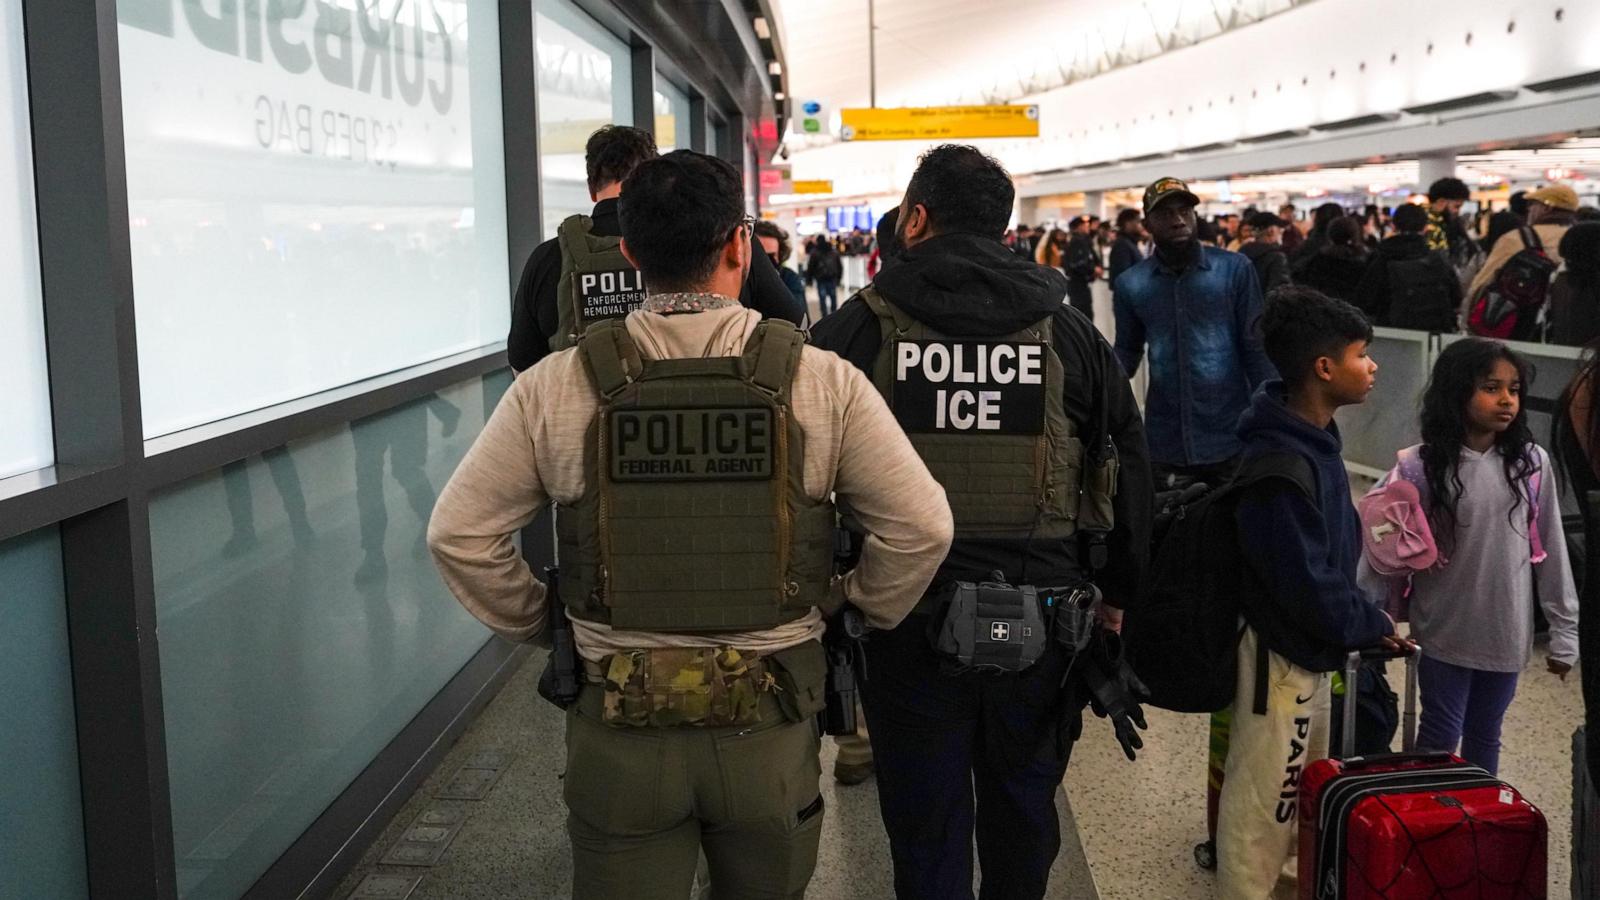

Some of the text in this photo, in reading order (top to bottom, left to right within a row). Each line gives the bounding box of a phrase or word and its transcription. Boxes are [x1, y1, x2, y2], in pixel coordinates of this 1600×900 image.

[581, 270, 643, 295] POLI
[588, 292, 646, 306] ENFORCEMEN
[584, 305, 625, 317] REMOVAL
[897, 342, 1042, 385] POLICE
[936, 389, 1002, 430] ICE
[617, 412, 766, 456] POLICE
[619, 457, 765, 475] FEDERAL AGENT
[1275, 716, 1311, 824] PARIS
